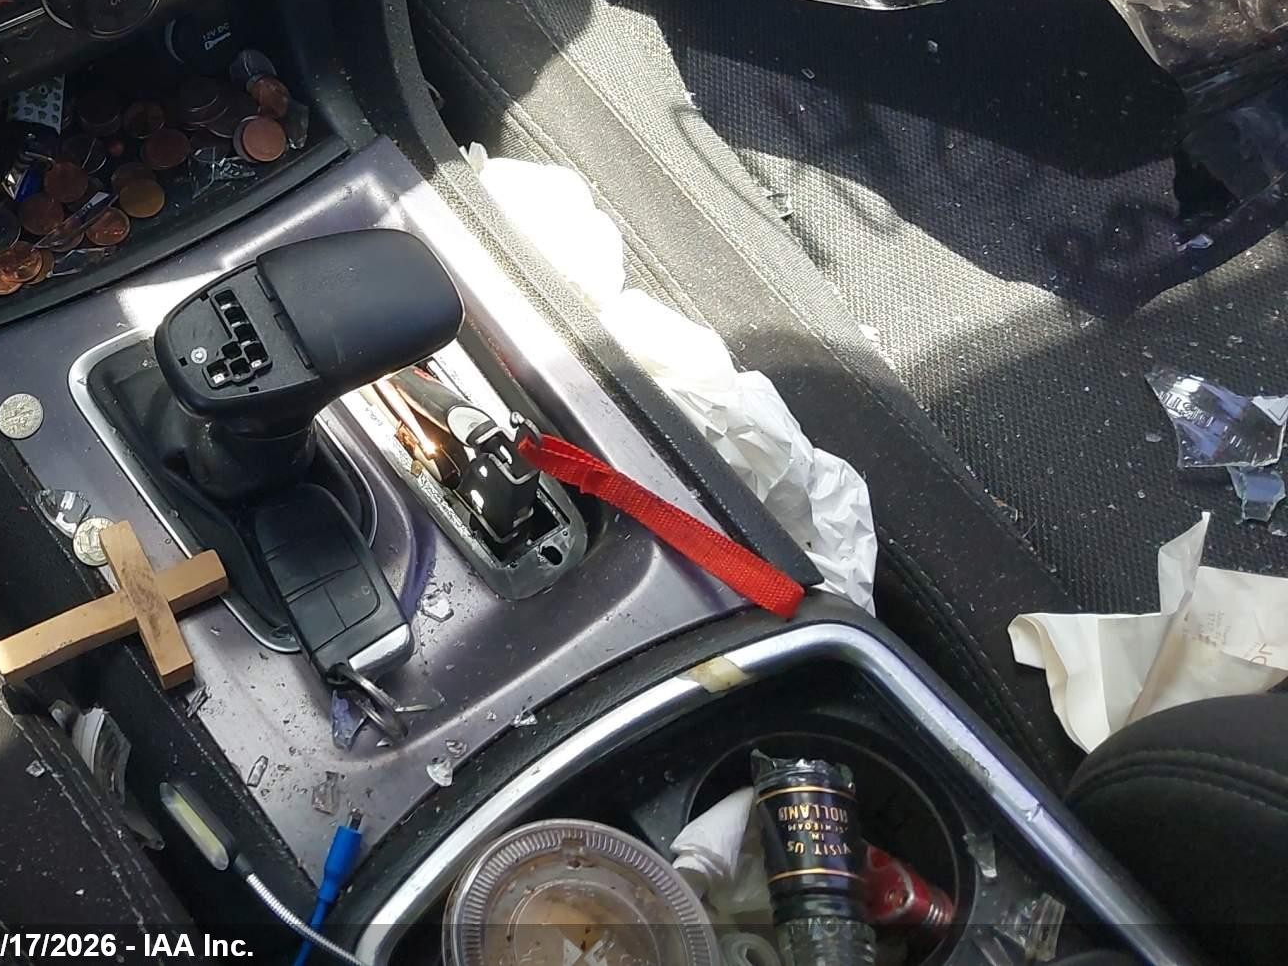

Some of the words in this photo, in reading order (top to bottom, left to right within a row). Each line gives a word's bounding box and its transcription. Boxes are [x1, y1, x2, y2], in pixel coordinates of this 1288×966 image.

[778, 803, 848, 823] HOLLAND
[811, 832, 824, 841] IN
[786, 841, 804, 854] US
[813, 841, 852, 856] VISIT
